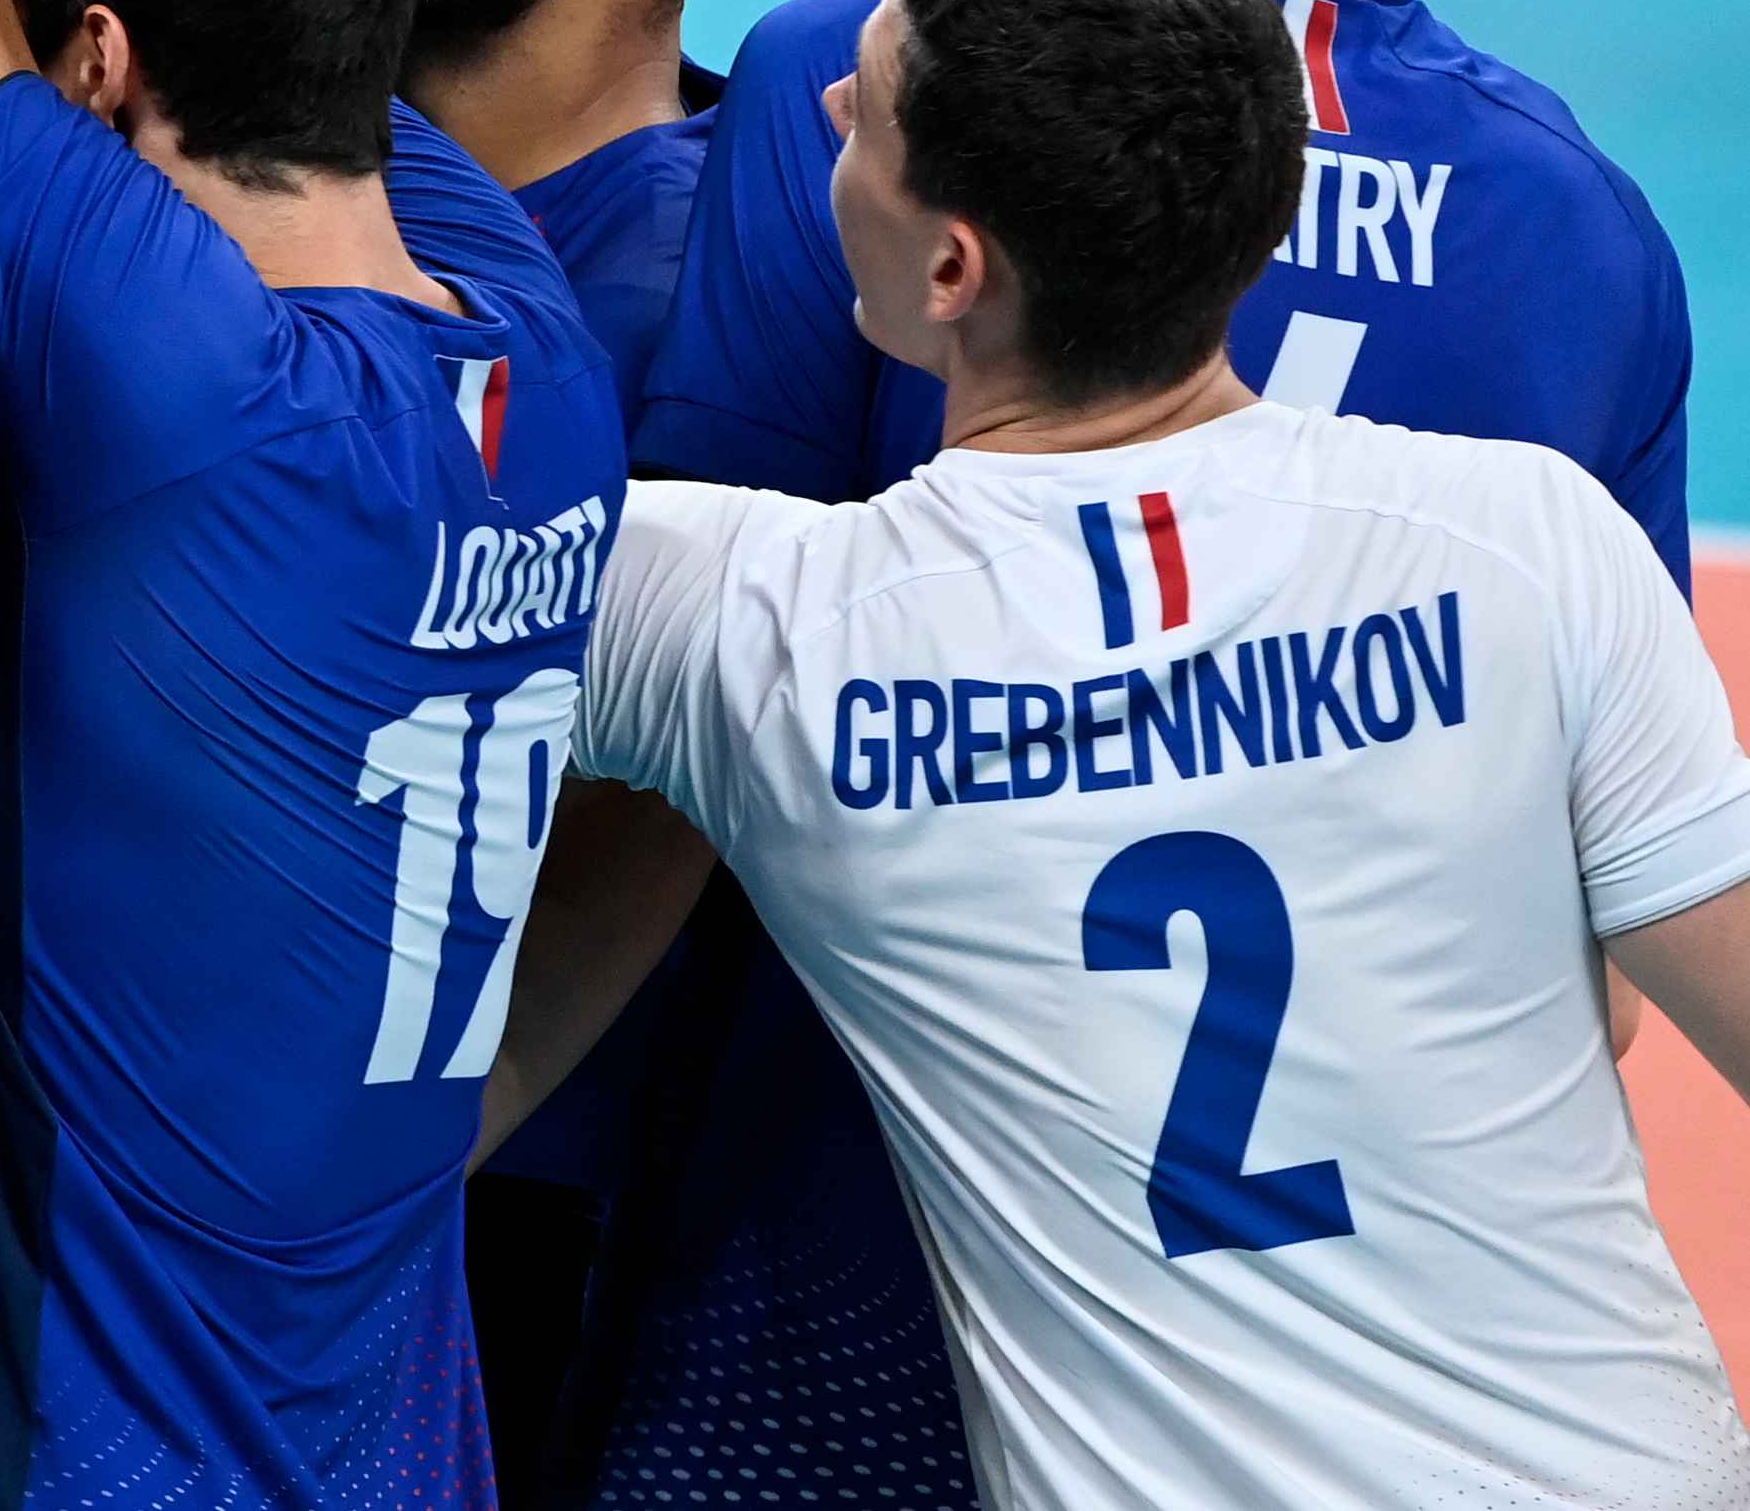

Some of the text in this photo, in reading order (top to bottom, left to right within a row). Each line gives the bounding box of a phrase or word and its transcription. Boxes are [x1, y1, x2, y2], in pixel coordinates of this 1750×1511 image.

[1273, 146, 1453, 288] TRY
[409, 494, 606, 651] LOUATI
[831, 590, 1466, 810] GREBENNIKOV
[354, 667, 581, 1086] 19
[1081, 829, 1356, 1259] 2
